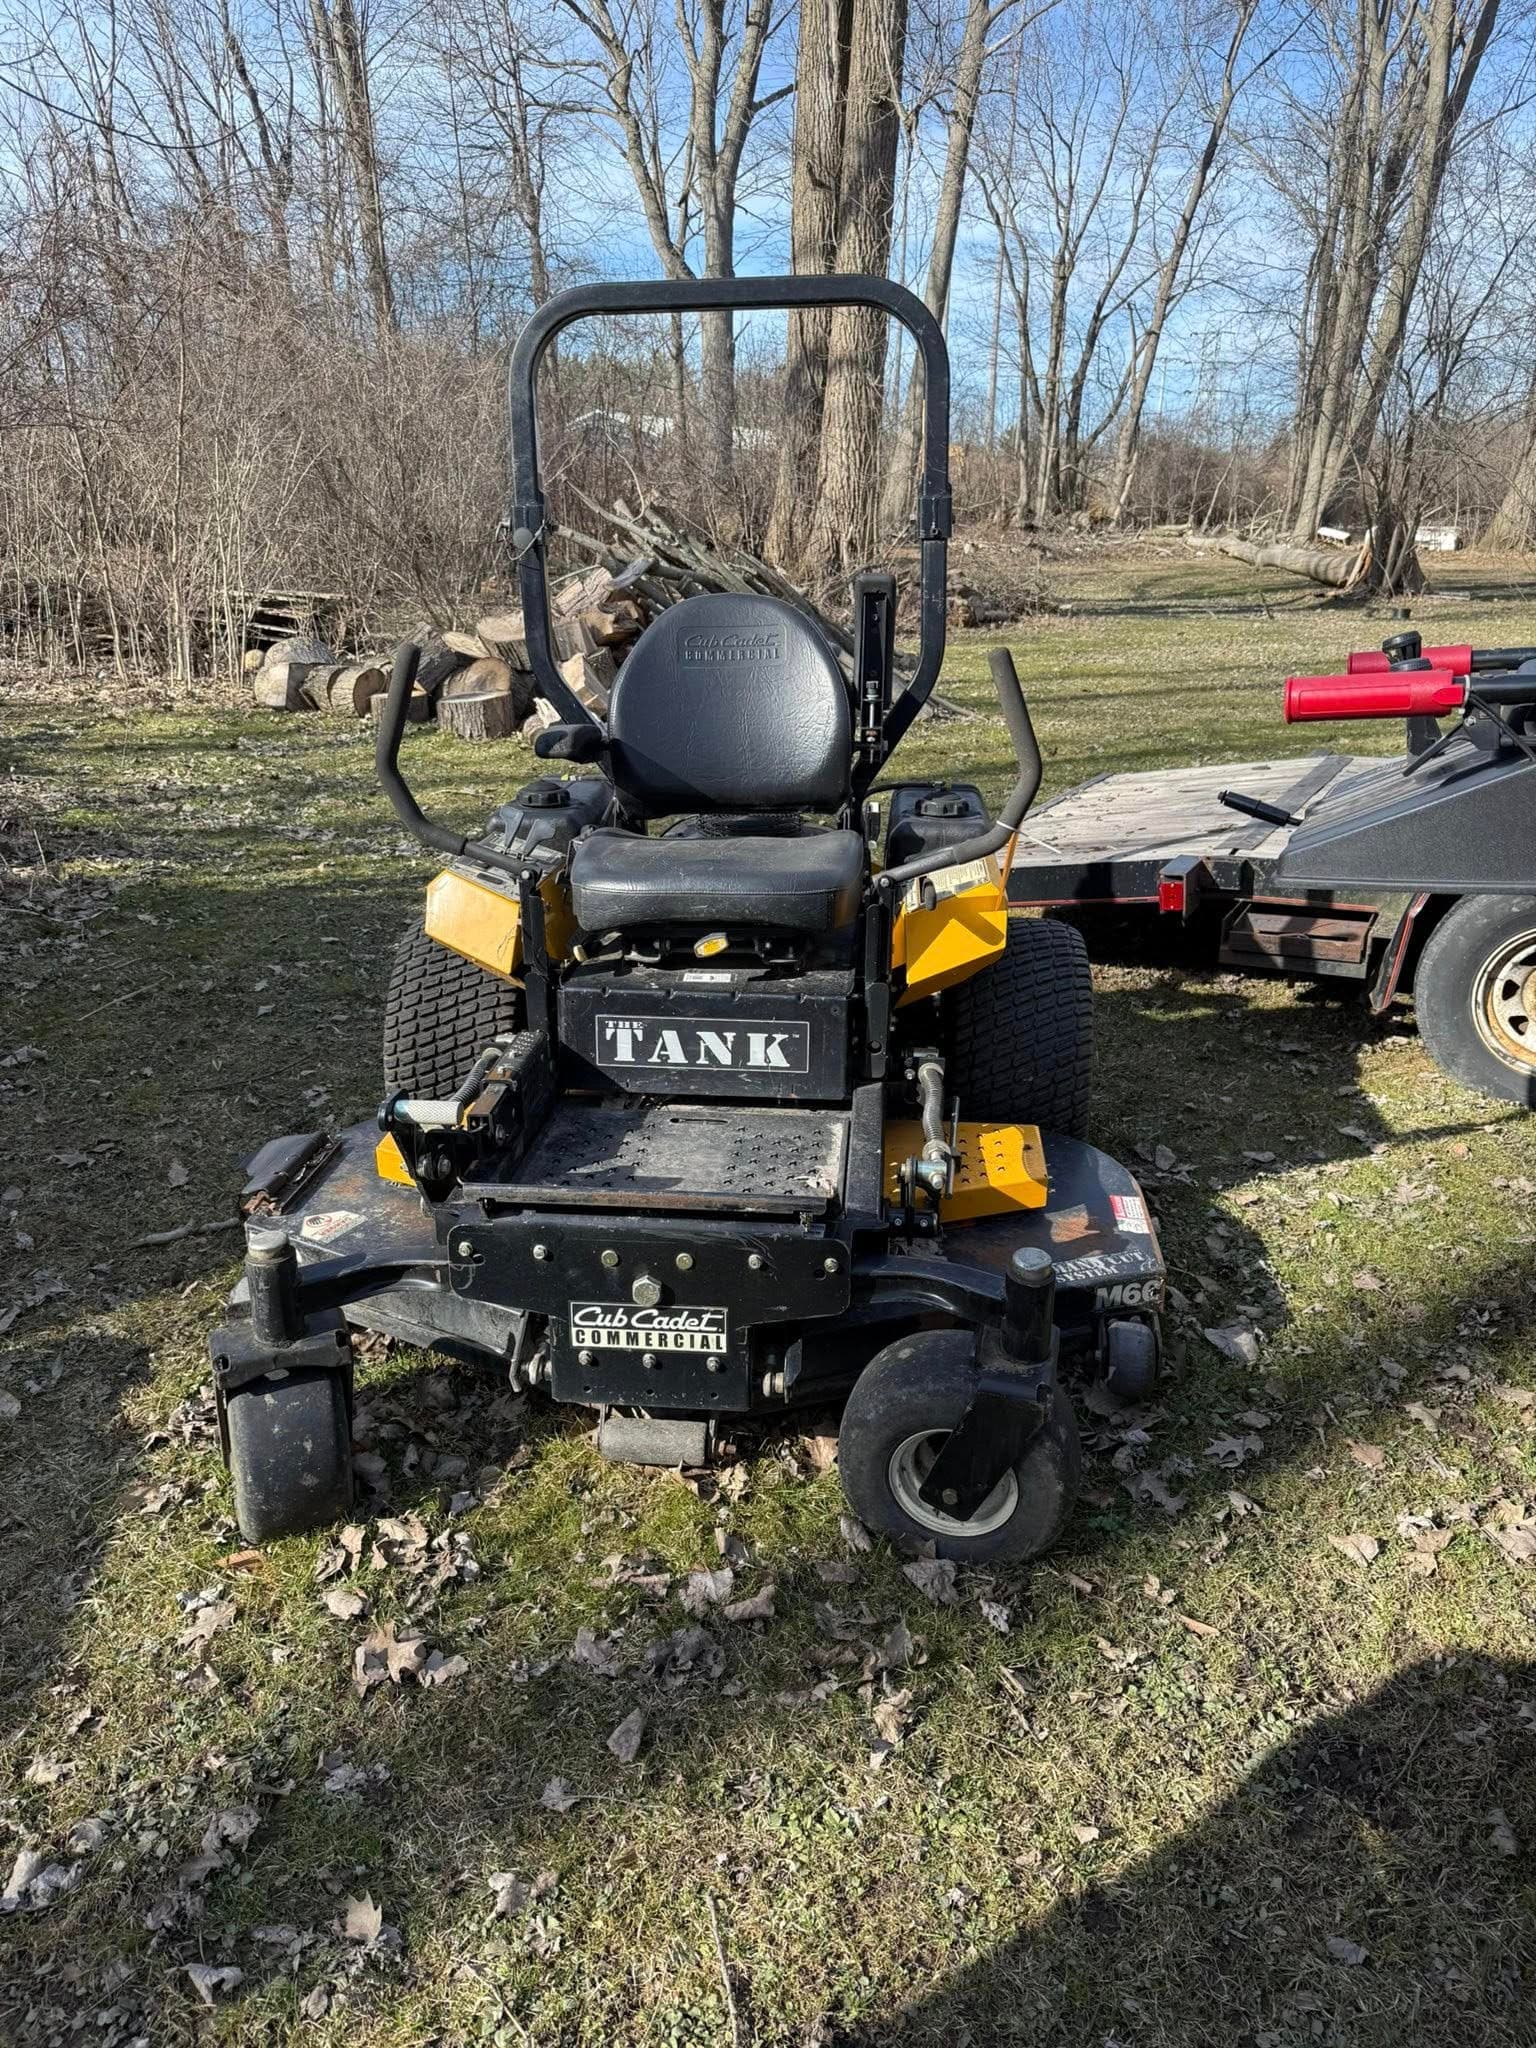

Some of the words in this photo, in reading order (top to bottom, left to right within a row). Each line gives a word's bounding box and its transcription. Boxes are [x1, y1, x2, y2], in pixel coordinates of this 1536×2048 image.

[684, 634, 718, 648] Cub
[720, 634, 779, 648] Cadet
[685, 648, 779, 661] COMMERCIAL
[605, 1020, 643, 1029] THE
[605, 1028, 790, 1068] TANK
[1106, 1250, 1145, 1265] CUT
[1056, 1265, 1119, 1283] SYSTEM
[574, 1306, 629, 1327] Cub
[631, 1309, 724, 1331] Cadet
[575, 1329, 723, 1350] COMMERCIAL
